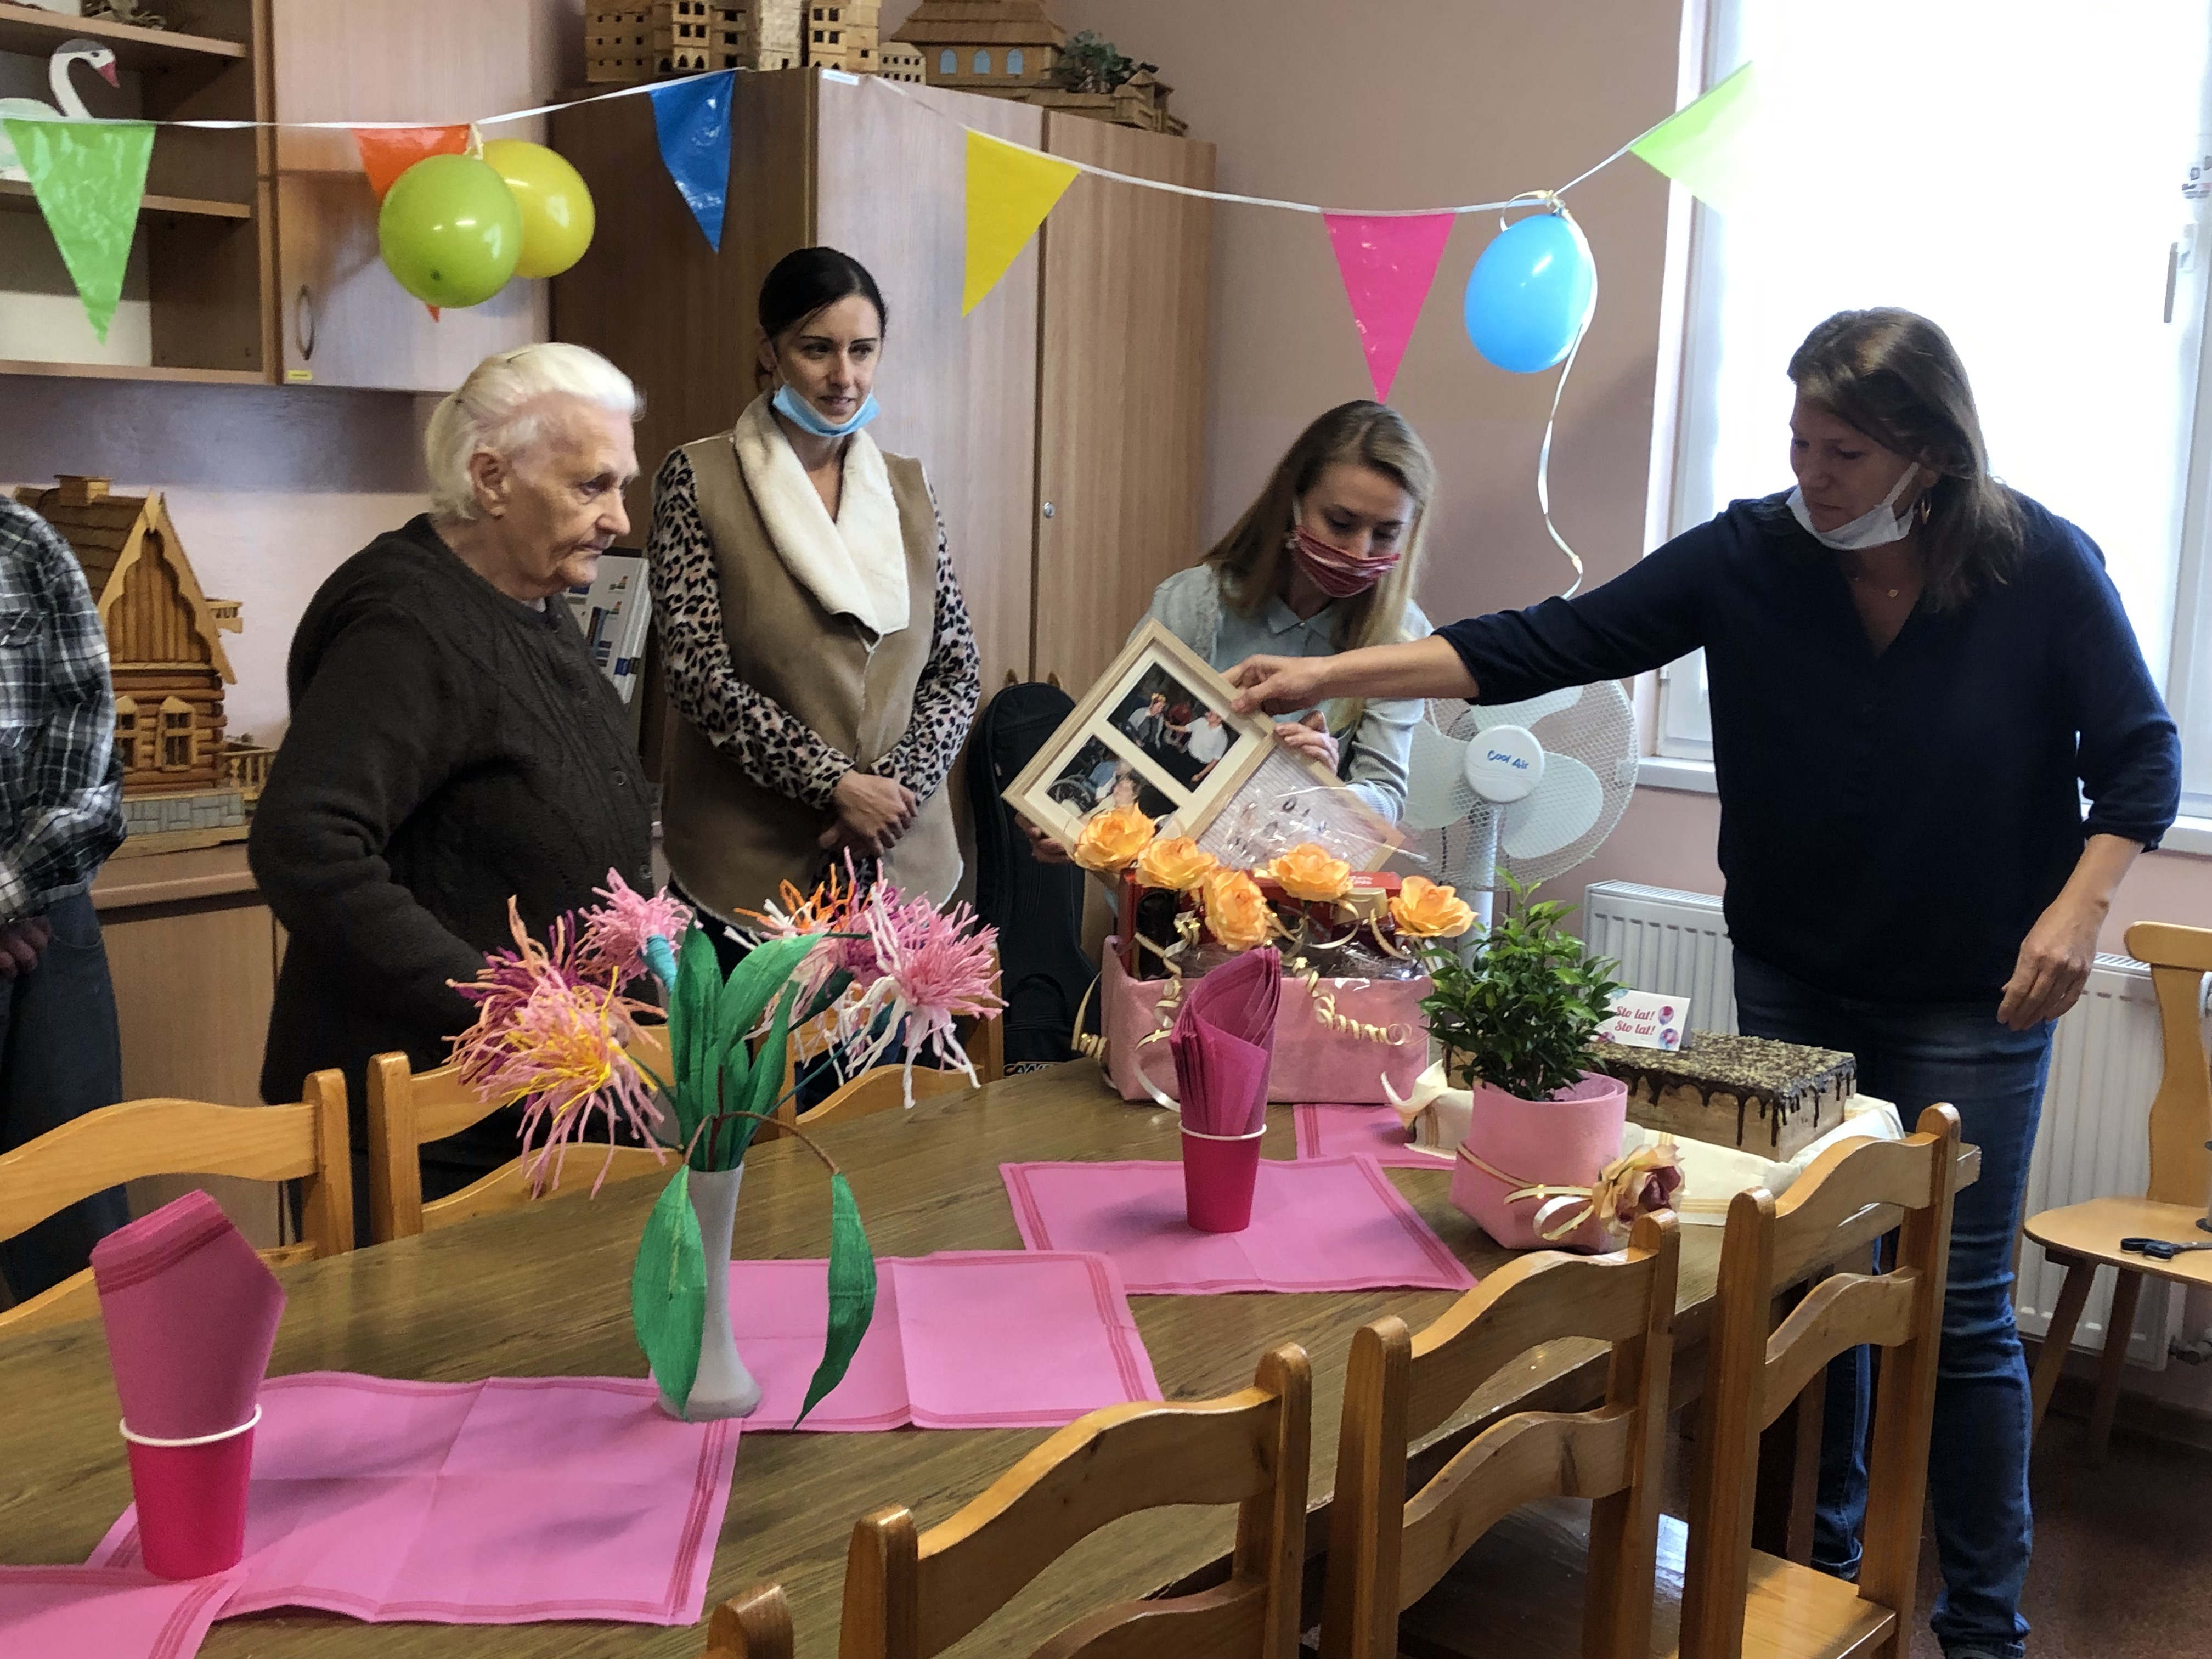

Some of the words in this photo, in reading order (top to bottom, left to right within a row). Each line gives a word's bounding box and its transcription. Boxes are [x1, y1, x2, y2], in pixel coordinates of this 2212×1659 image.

[1487, 750, 1511, 763] Cool
[1511, 758, 1529, 769] Air
[1616, 1006, 1632, 1018] Sto
[1634, 1009, 1656, 1021] lat!
[1615, 1020, 1633, 1032] Sto
[1634, 1024, 1656, 1036] lat!
